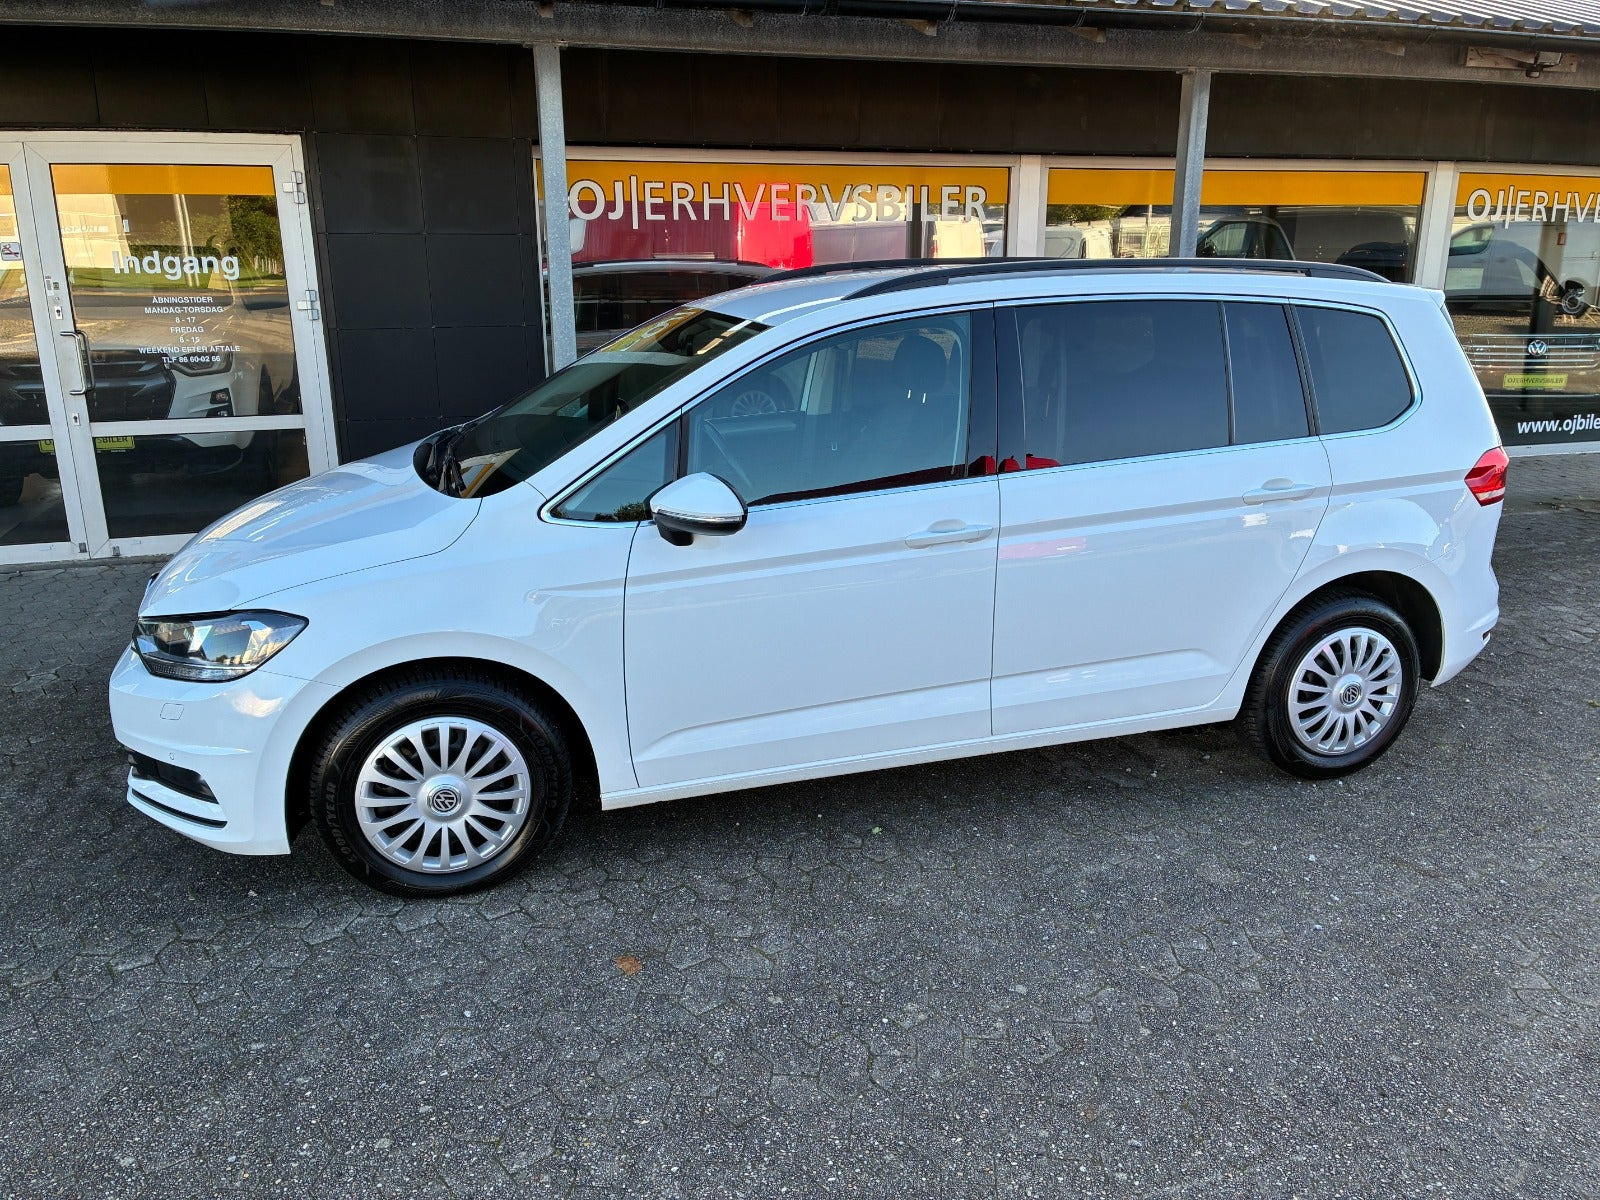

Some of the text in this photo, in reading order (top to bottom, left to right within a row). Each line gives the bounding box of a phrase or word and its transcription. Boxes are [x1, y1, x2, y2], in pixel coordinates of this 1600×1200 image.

[112, 250, 240, 281] Indgang
[152, 296, 213, 304] ÅBNINGSTIDER
[144, 306, 225, 314] MANDAG-TORSDAG
[138, 346, 180, 354] WEEKEND
